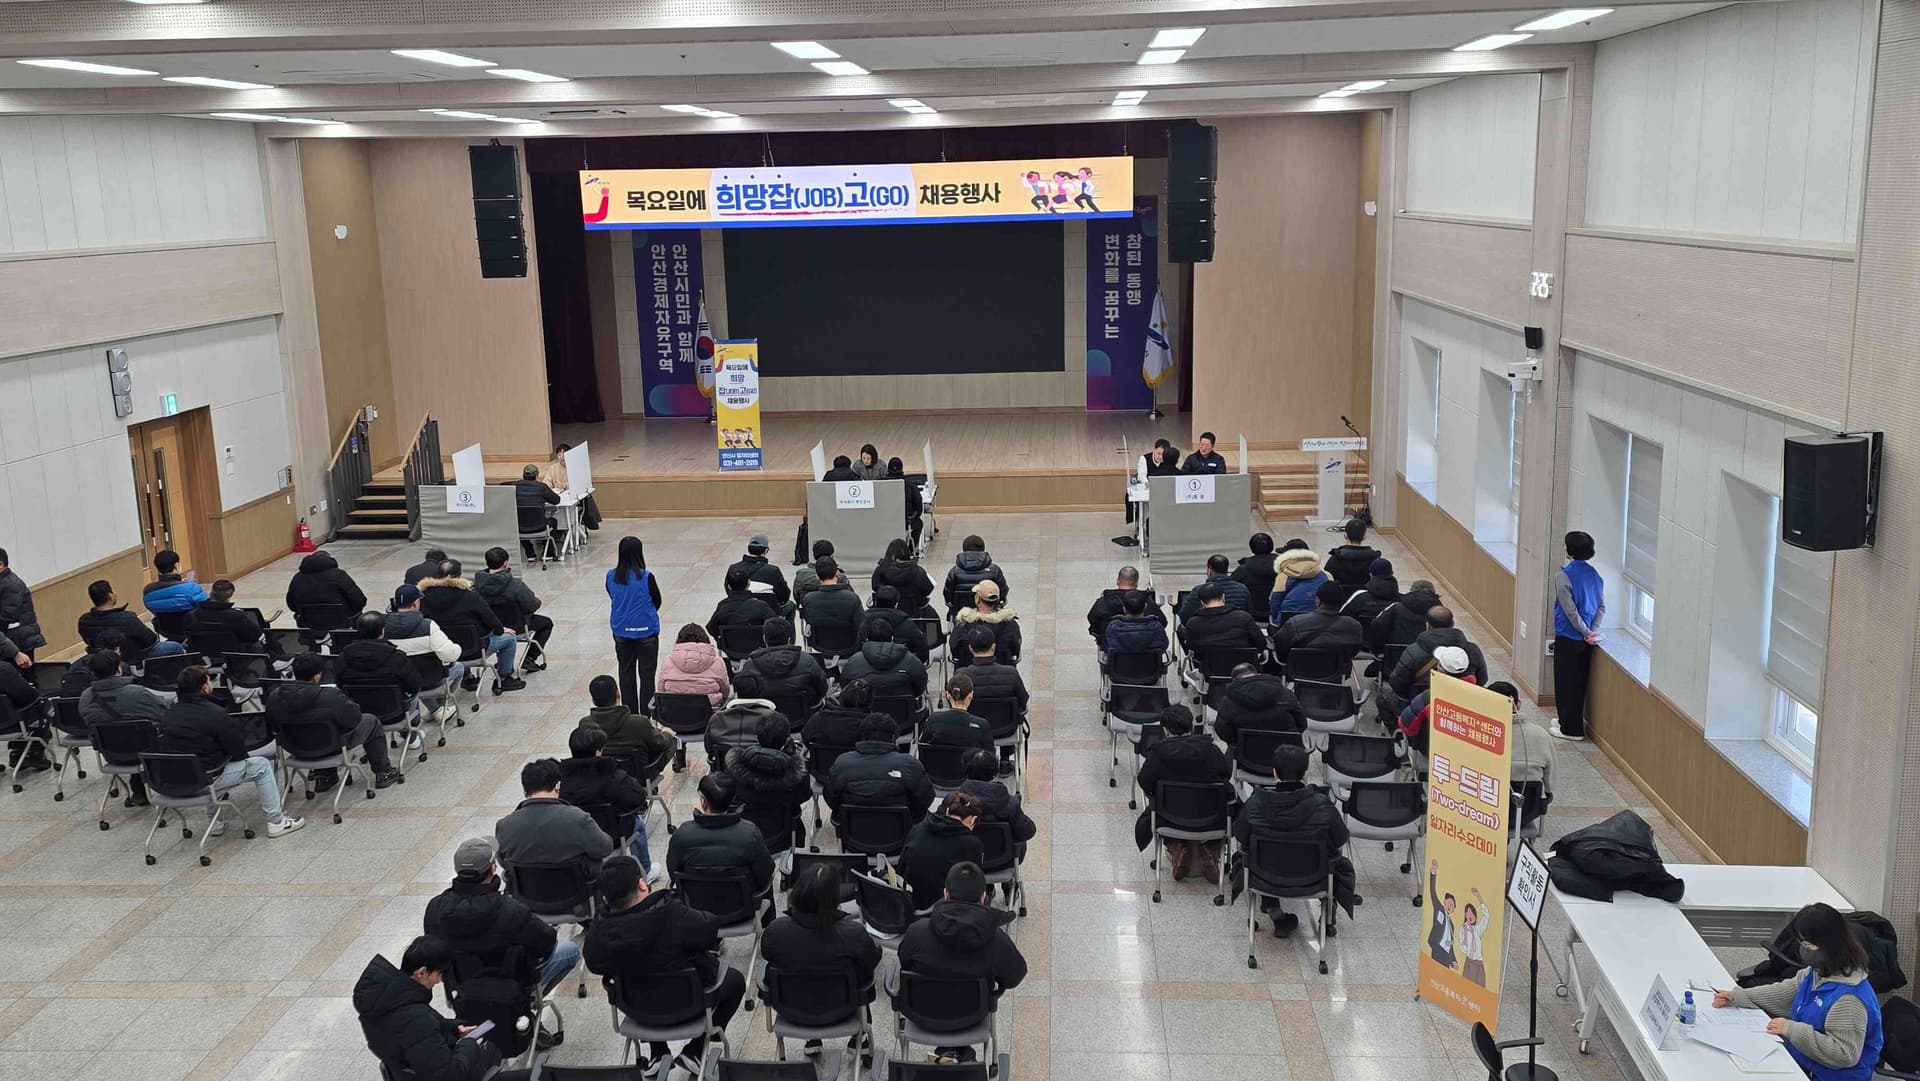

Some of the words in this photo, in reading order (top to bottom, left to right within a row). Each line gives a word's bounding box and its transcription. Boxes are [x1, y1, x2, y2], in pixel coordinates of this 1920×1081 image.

[627, 189, 707, 211] 목요일에
[919, 182, 1002, 206] 채용행사
[1104, 234, 1120, 283] 변화를
[1126, 233, 1142, 266] 참된
[672, 244, 692, 325] 안산시민과
[1126, 273, 1142, 305] 동행
[651, 244, 673, 374] 안산경제자유구역
[1104, 290, 1120, 339] 꿈꾸는
[677, 331, 694, 363] 함께
[1432, 753, 1500, 808] 투-드림
[1431, 785, 1500, 831] (Two-dream)
[1430, 814, 1497, 857] 일자리수요데이
